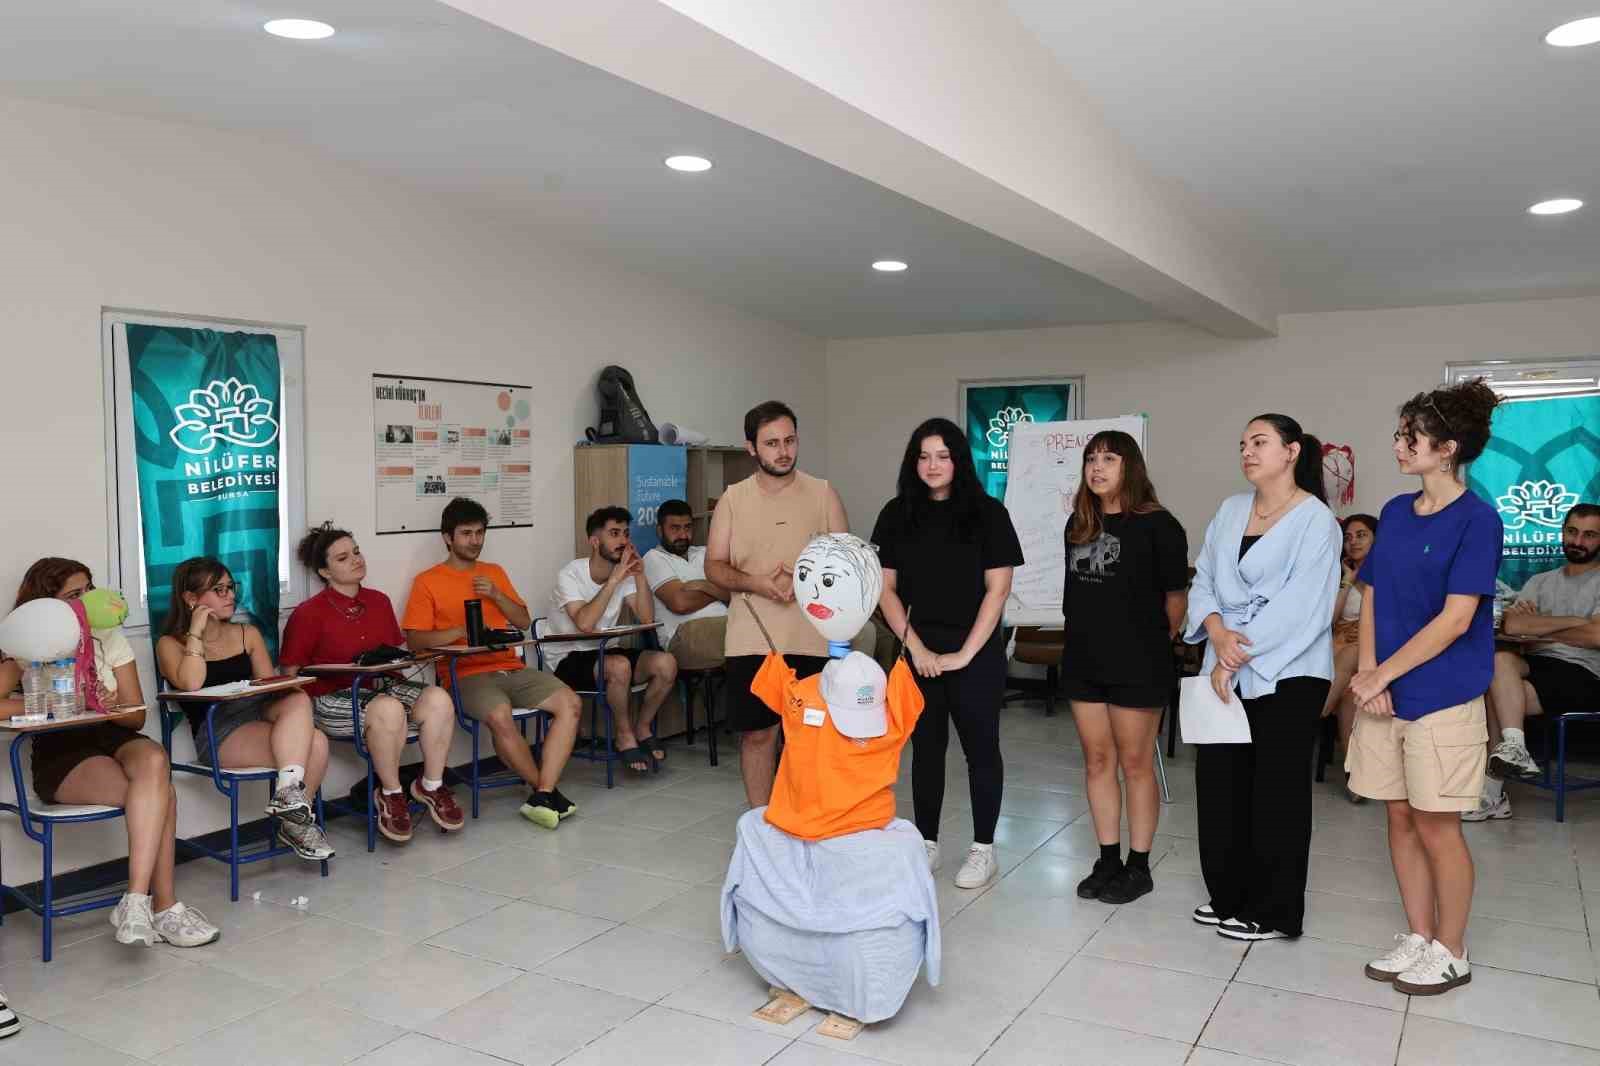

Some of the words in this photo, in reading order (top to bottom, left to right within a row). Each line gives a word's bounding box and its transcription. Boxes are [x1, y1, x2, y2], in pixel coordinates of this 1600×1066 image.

[184, 451, 276, 477] NİLÜFER
[187, 472, 276, 494] BELEDİYESİ
[218, 490, 249, 501] BURSA
[638, 506, 660, 527] 20
[1503, 530, 1563, 544] NİLÜF
[1503, 545, 1566, 556] BELEDİY
